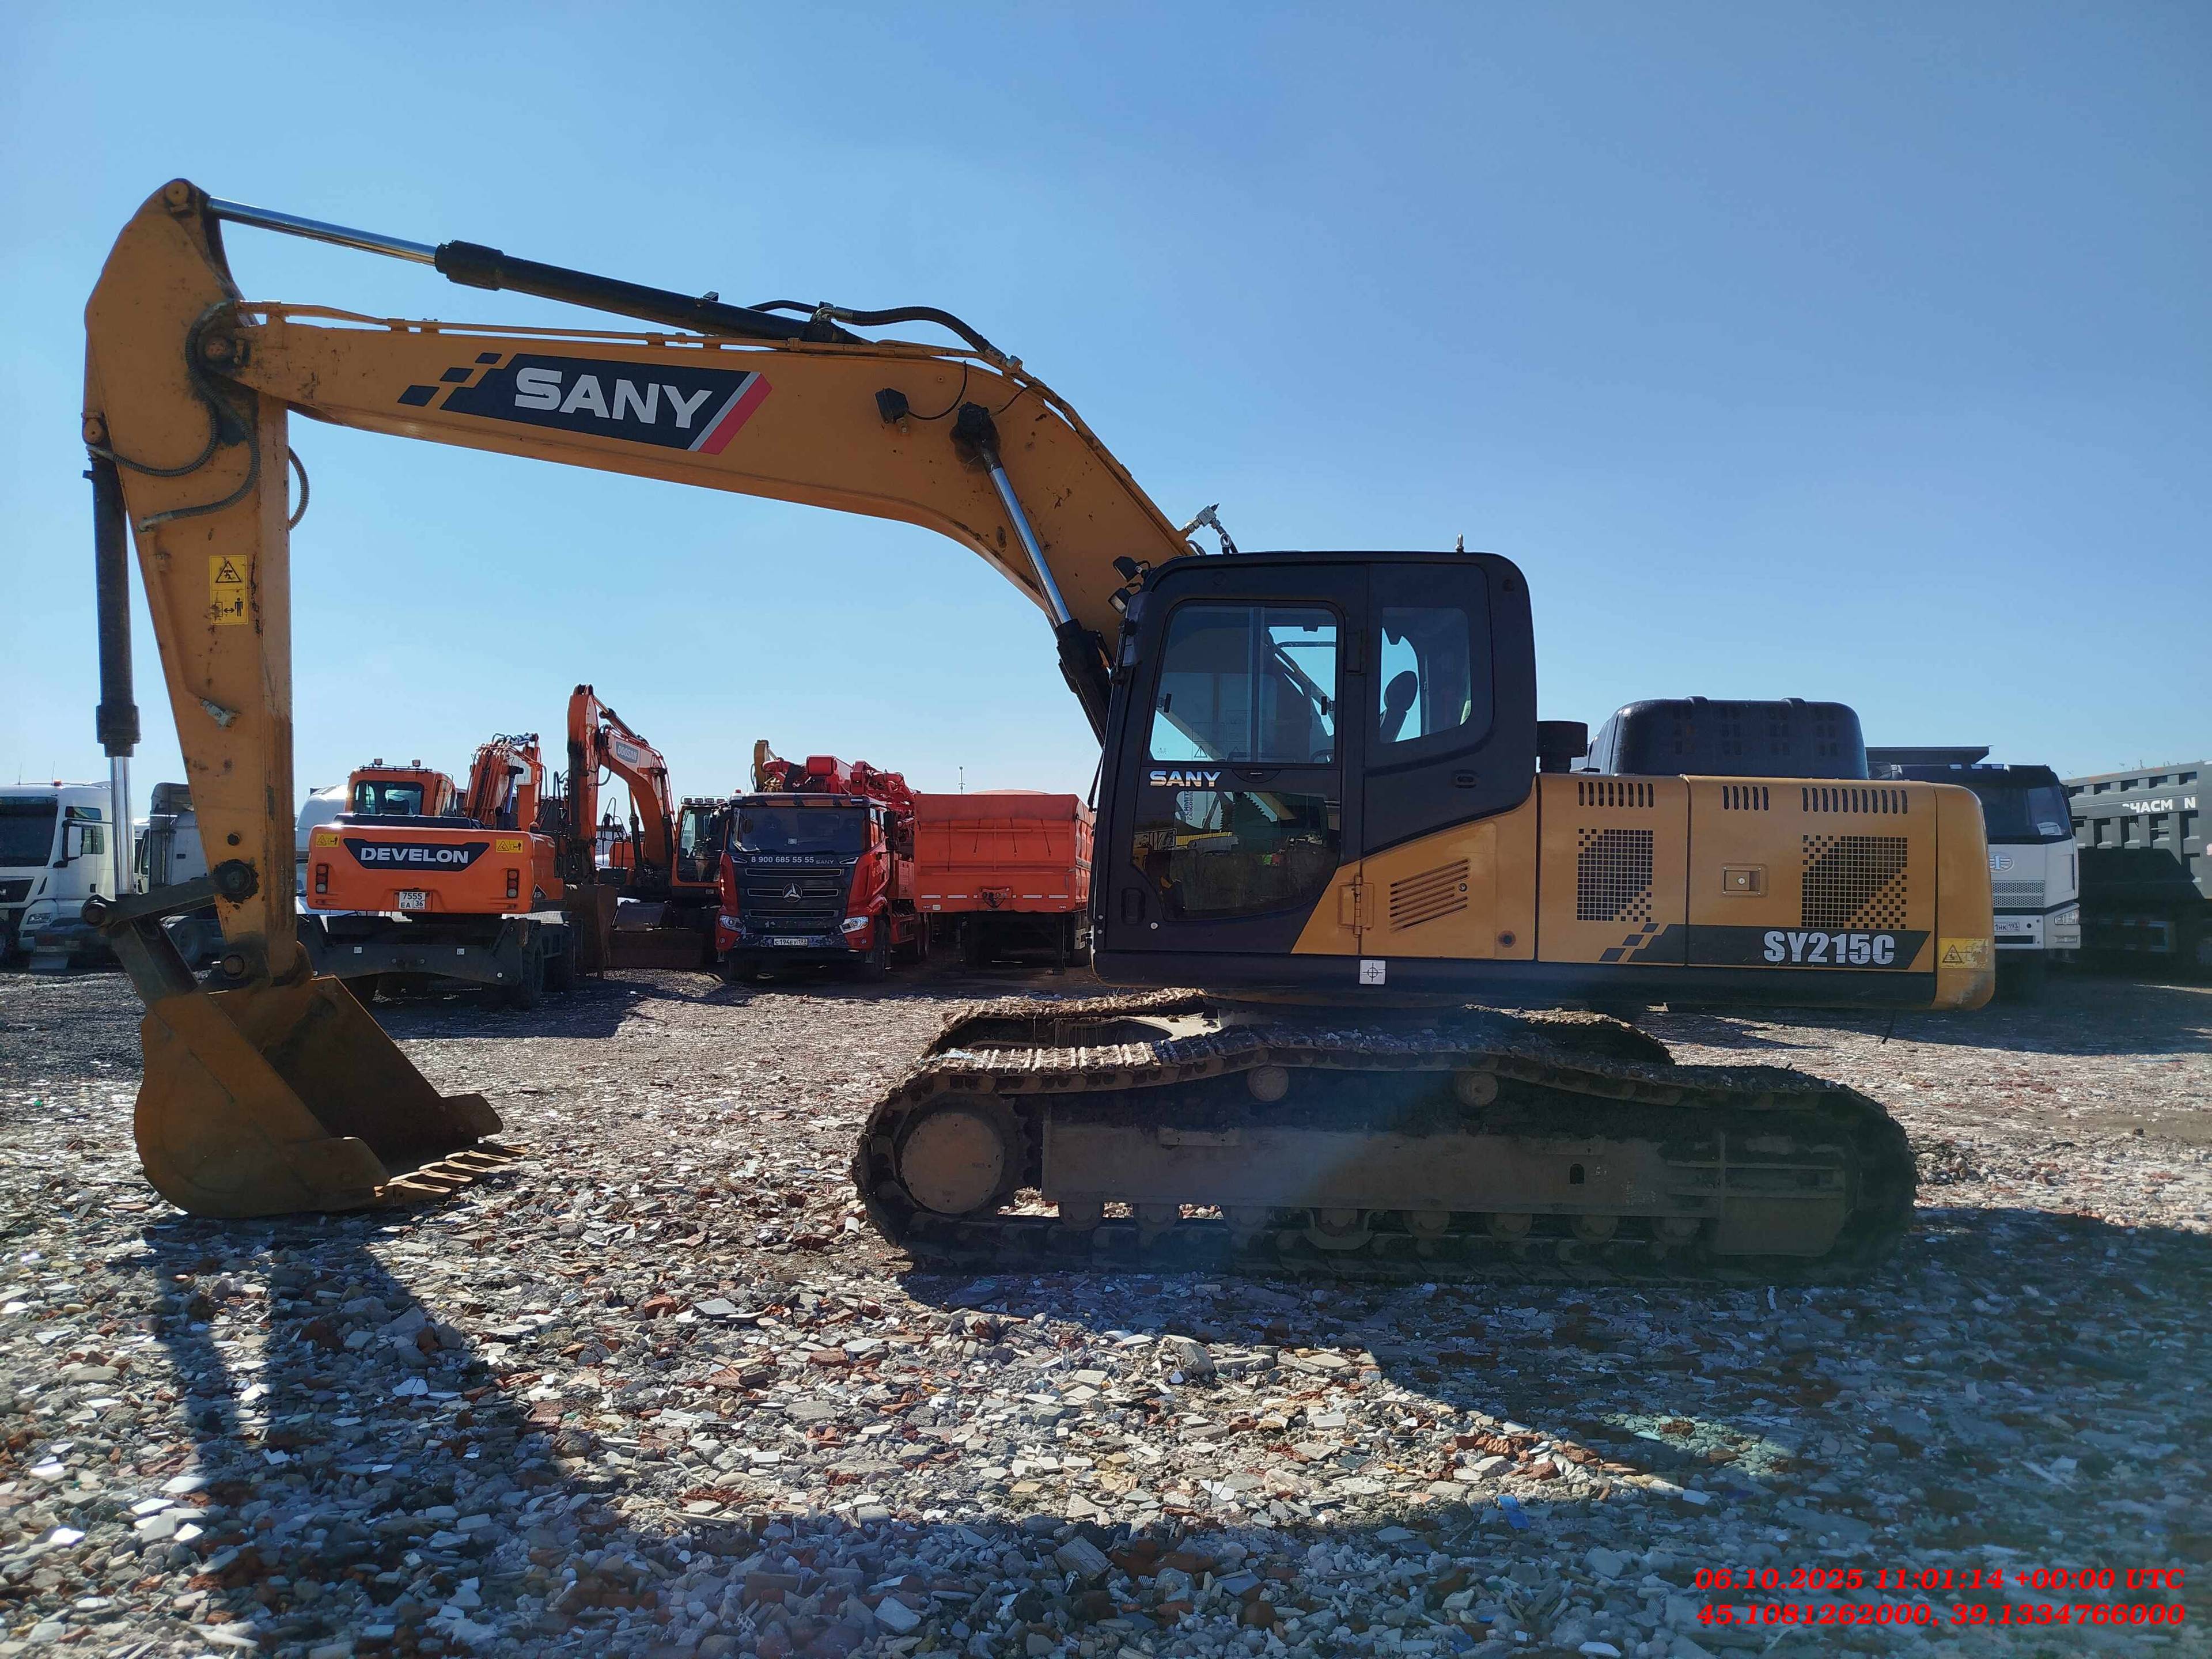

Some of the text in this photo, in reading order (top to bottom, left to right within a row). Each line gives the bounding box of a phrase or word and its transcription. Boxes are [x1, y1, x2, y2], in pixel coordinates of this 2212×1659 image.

[514, 367, 713, 429] SANY
[618, 745, 637, 760] DOOSAN
[1150, 771, 1221, 787] SANY
[361, 848, 469, 863] DEVELON
[1763, 931, 1895, 965] SY215C
